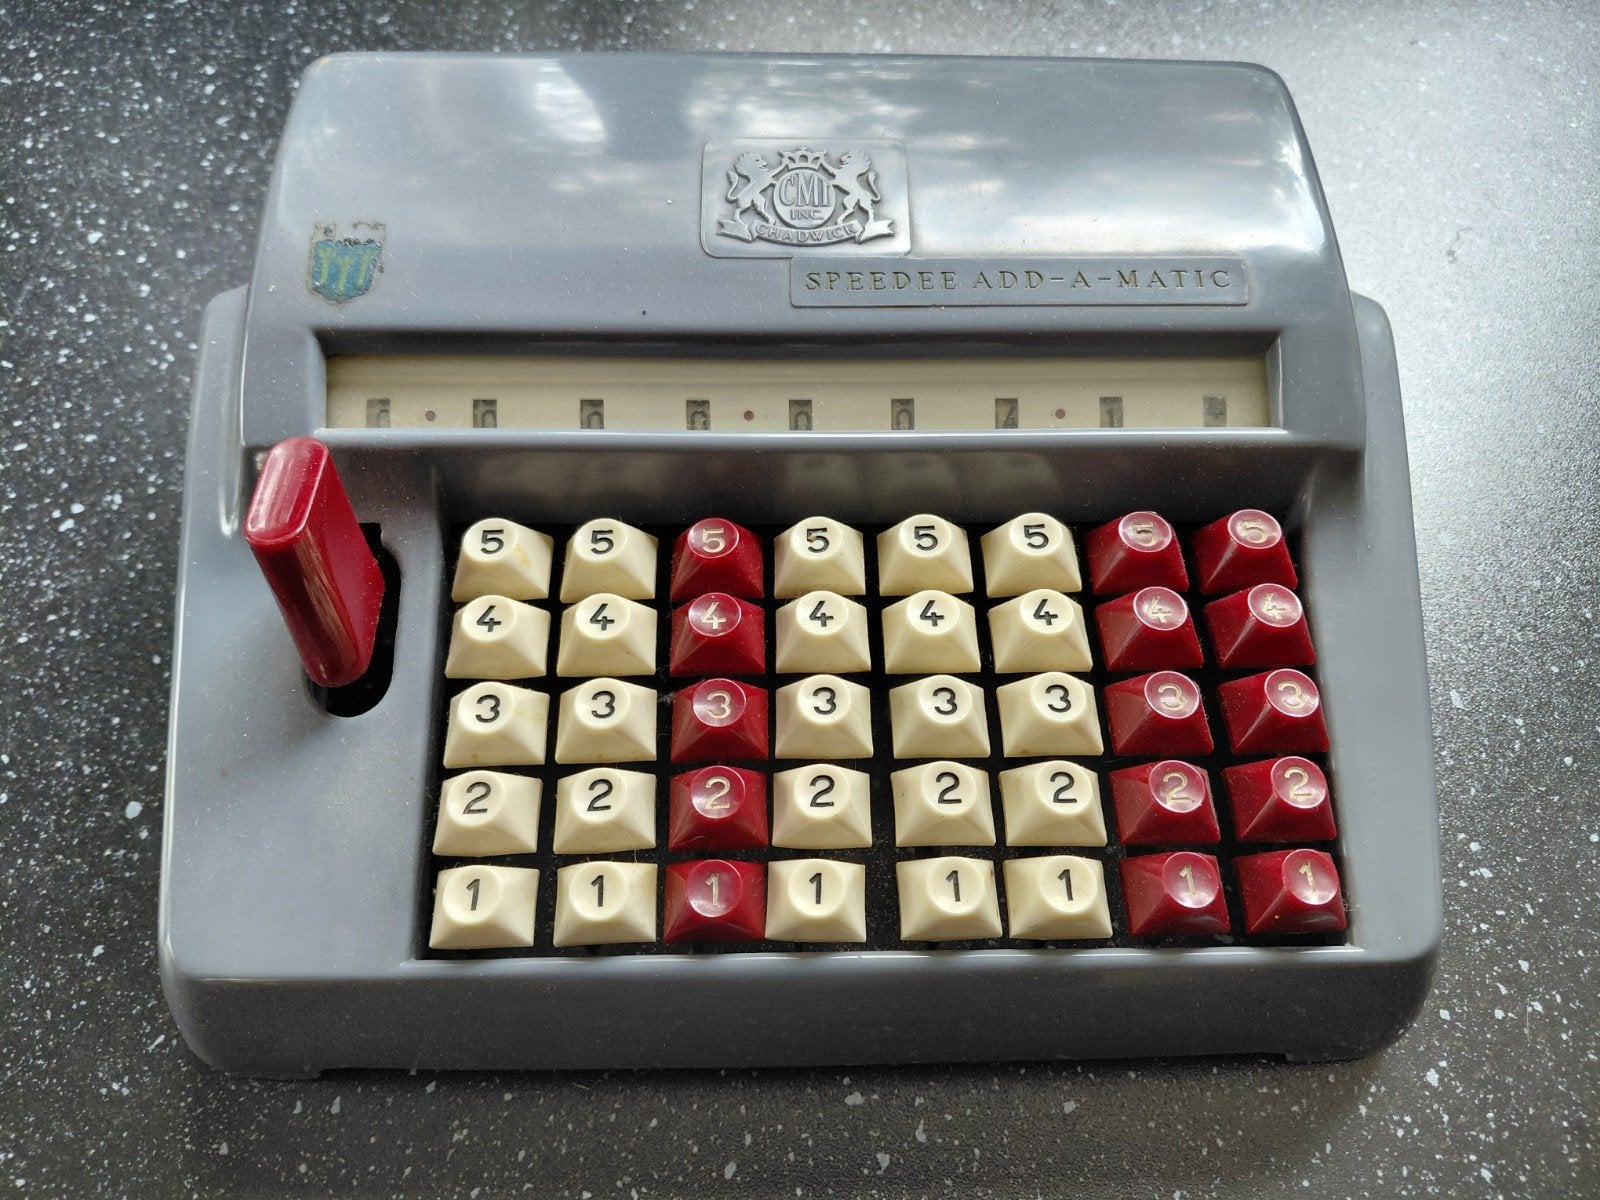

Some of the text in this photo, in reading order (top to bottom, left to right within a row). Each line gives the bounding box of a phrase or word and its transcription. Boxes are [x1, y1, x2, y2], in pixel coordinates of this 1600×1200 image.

[780, 172, 829, 209] CMI
[755, 222, 859, 243] CHADWICK
[805, 269, 1232, 291] SPEEDEE ADD-A-MATIC
[481, 518, 1268, 555] 5 5 5 5 5 5 5 5
[477, 592, 1286, 632] 4 4 4 4 4 4 4 4
[476, 681, 1305, 723] 3 3 3 3 3 3 3 3
[462, 766, 1312, 815] 2 2 2 2 2 2 2 2
[466, 860, 1316, 911] 1 1 1 1 1 1 1 1
